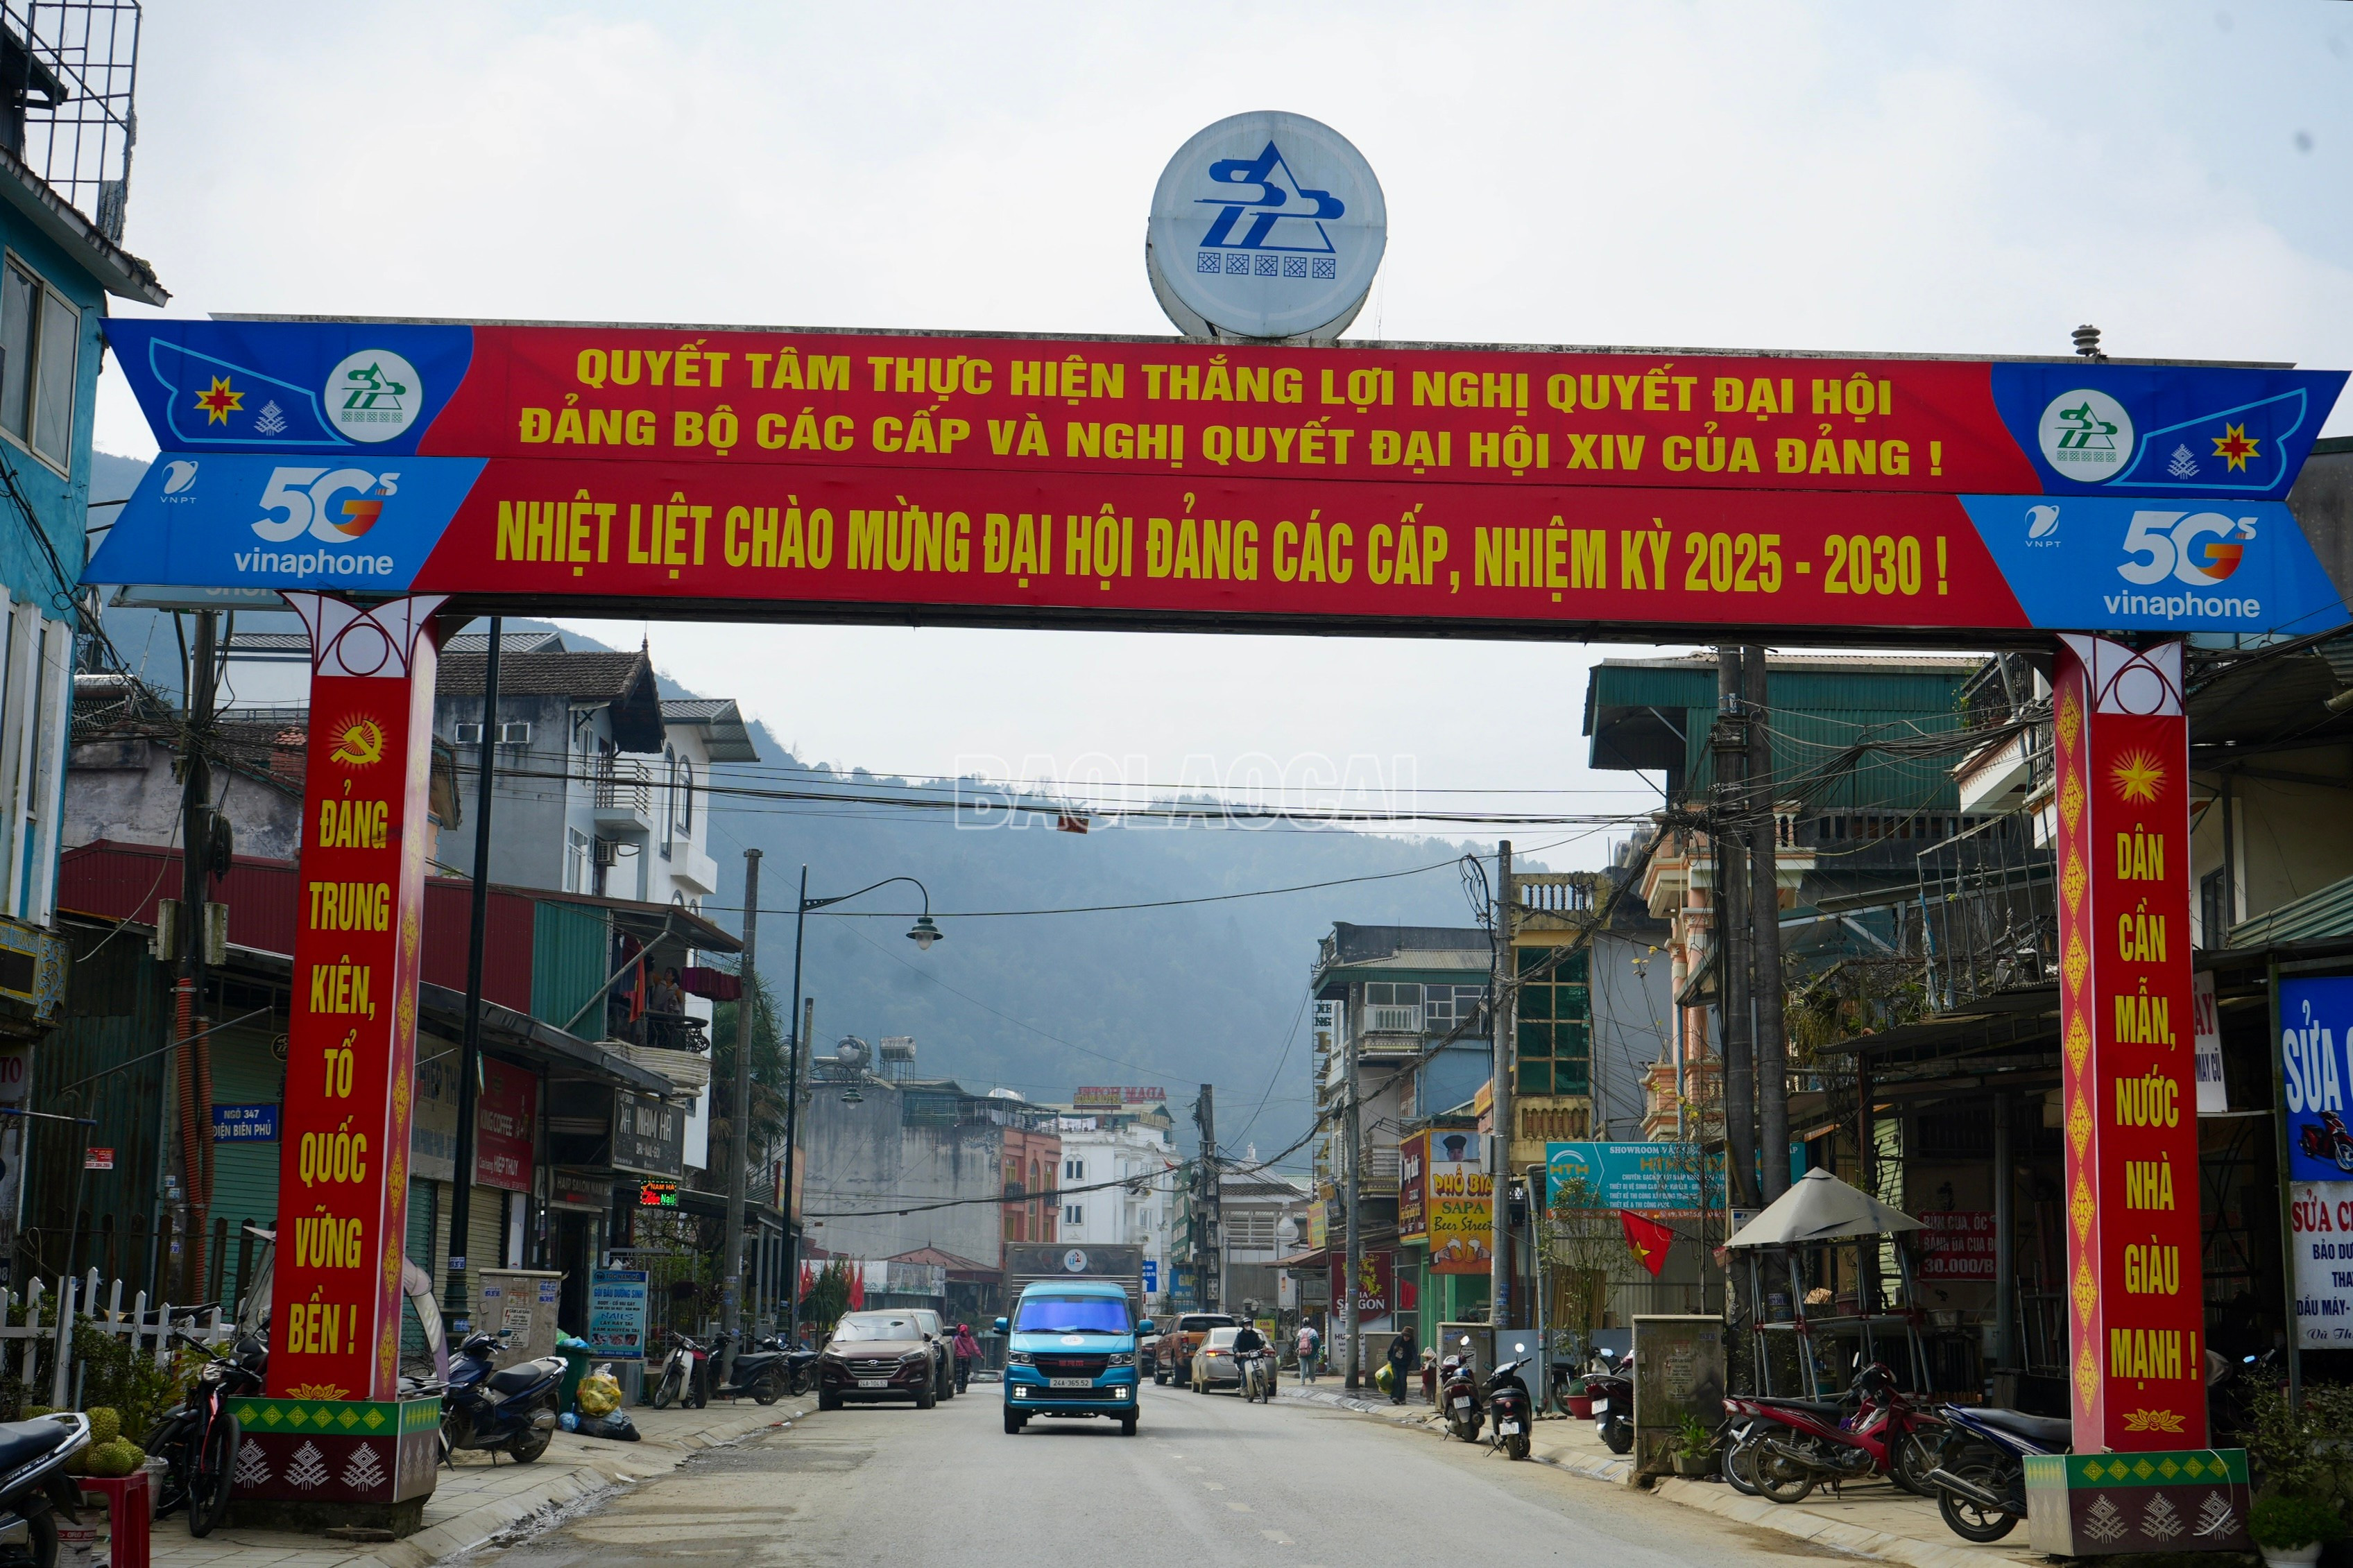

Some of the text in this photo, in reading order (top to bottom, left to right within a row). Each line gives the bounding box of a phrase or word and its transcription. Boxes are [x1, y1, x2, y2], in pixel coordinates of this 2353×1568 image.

[576, 339, 1891, 422] QUYẾT TÂM THỰC HIỆN THẮNG LỢI NGHỊ QUYẾT ĐẠI HỘI
[519, 393, 1942, 476] ĐẢNG BỘ CÁC CẤP VÀ NGHỊ QUYẾT ĐẠI HỘI XIV CỦA ĐẢNG !
[160, 496, 196, 504] VNPT
[234, 547, 394, 579] vinaphone
[496, 489, 1948, 603] NHIỆT LIỆT CHÀO MỪNG ĐẠI HỘI ĐẢNG CÁC CẤP, NHIỆM KỲ 2025 2030 !
[2103, 590, 2261, 620] vinaphone
[319, 779, 388, 849] ĐẢNG
[2117, 823, 2164, 881] DÂN
[309, 881, 390, 931] TRUNG
[2119, 897, 2166, 963] CẦN
[309, 954, 375, 1021] KIÊN,
[2114, 976, 2176, 1051] MẪN,
[323, 1028, 357, 1098] TỔ
[2283, 999, 2343, 1113] SỬA
[2116, 1065, 2179, 1128] NƯỚC
[233, 1121, 252, 1137] BIÊN
[254, 1119, 271, 1136] PHỦ
[243, 1110, 259, 1119] 347
[479, 1108, 513, 1137] KING COFFEE
[636, 1106, 672, 1141] NAM HÀ
[299, 1115, 367, 1188] QUỐC
[557, 1176, 572, 1189] HAIR
[572, 1178, 588, 1192] SALON
[666, 1182, 675, 1190] HÀ
[1432, 1164, 1464, 1196] PHỐ
[1468, 1173, 1494, 1197] BIA
[1550, 1164, 1589, 1175] HTH
[2126, 1152, 2174, 1210] NHÀ
[1434, 1216, 1457, 1232] Beer
[1461, 1217, 1493, 1232] Street
[1442, 1201, 1485, 1214] SAPA
[1973, 1211, 1987, 1230] ỐC
[2291, 1188, 2333, 1233] SỬA
[296, 1205, 362, 1268] VỮNG
[1967, 1237, 1985, 1252] CUA
[2313, 1239, 2335, 1260] BẢO
[2124, 1234, 2179, 1295] GIÀU
[632, 1290, 643, 1298] SINH
[1337, 1298, 1385, 1309] SAGON
[2297, 1295, 2318, 1316] DẦU
[288, 1285, 357, 1354] BỀN !
[601, 1312, 633, 1320] NAILS
[2110, 1327, 2198, 1390] MẠNH !
